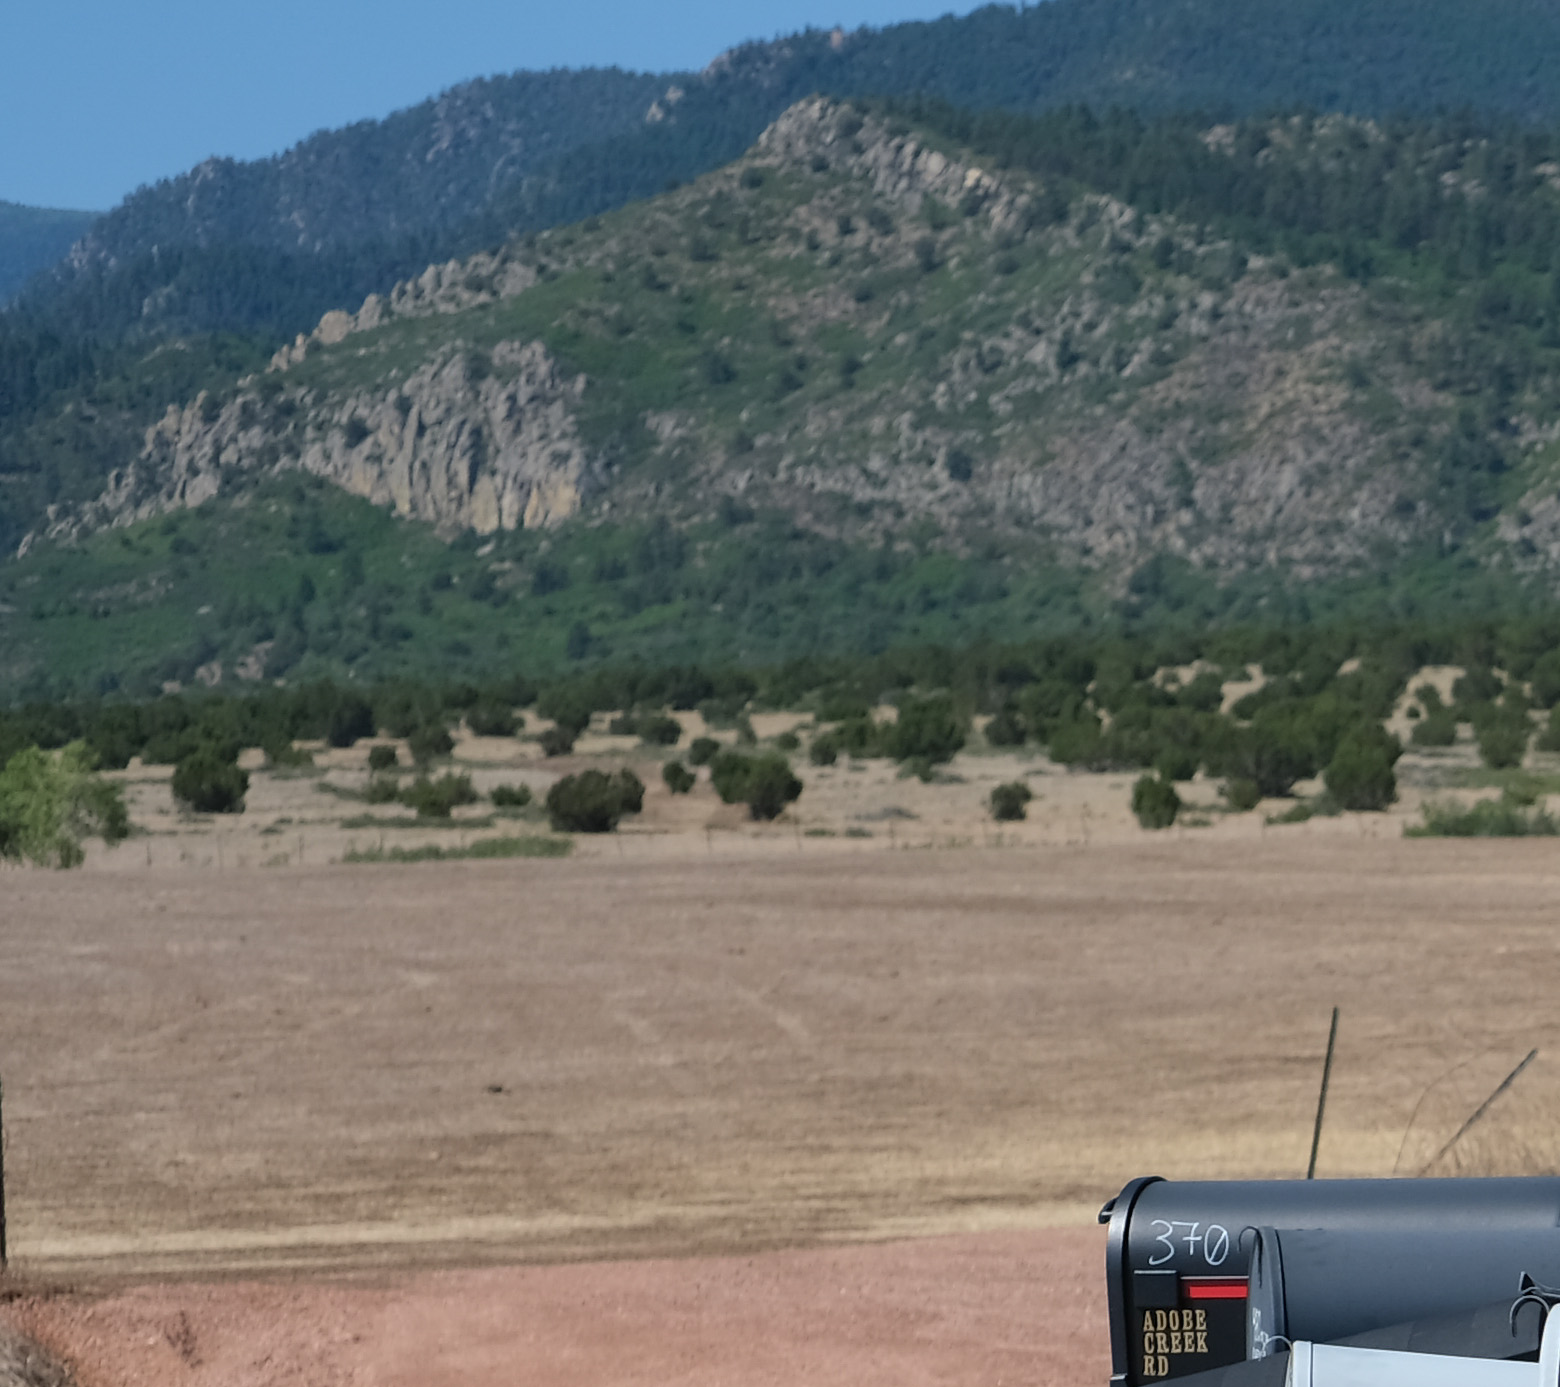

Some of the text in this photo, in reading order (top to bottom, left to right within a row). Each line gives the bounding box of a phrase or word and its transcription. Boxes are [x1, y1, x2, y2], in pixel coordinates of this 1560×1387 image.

[1148, 1220, 1230, 1265] 370
[1143, 1310, 1208, 1331] ADOBE
[1143, 1332, 1209, 1354] CREEK
[1143, 1355, 1169, 1377] RD
